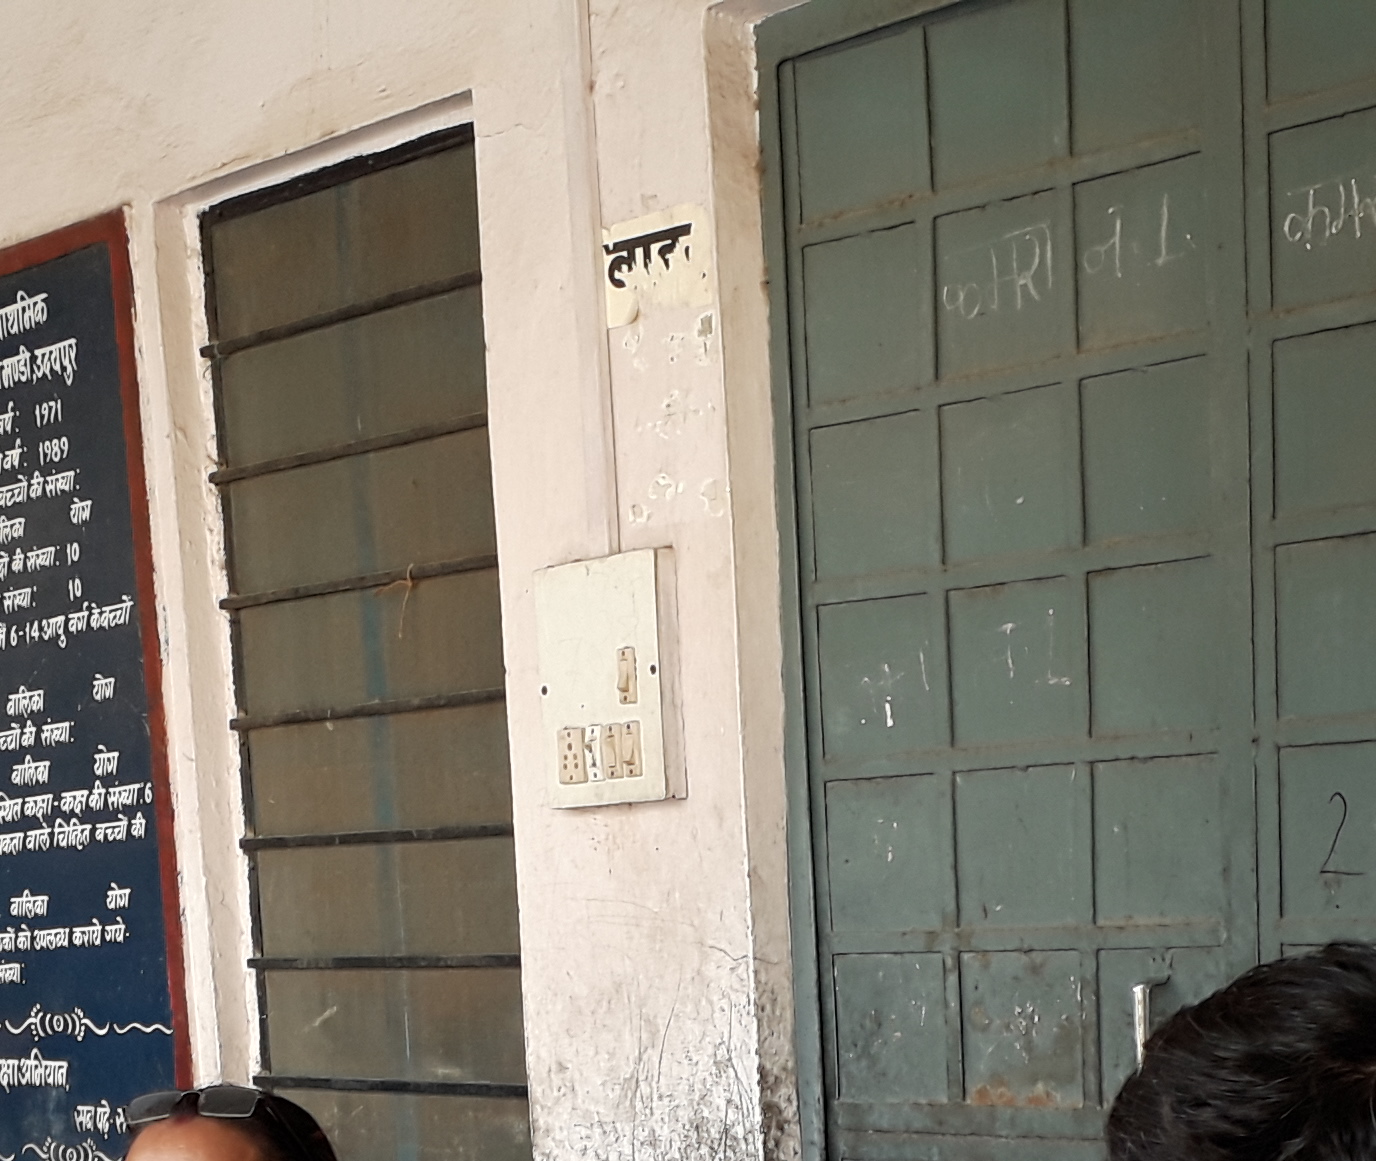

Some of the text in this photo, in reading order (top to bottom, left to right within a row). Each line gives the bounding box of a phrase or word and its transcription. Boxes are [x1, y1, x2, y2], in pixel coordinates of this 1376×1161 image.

[35, 399, 62, 428] 1971
[39, 436, 69, 466] 1989
[29, 470, 44, 500] की
[70, 497, 93, 525] योग
[11, 547, 24, 574] की
[66, 542, 80, 566] 10
[68, 577, 82, 601] 10
[10, 619, 39, 647] 6-14
[41, 615, 67, 649] आयु
[68, 601, 89, 635] वर्ग
[6, 685, 44, 718] बालिका
[92, 673, 115, 702] योग
[21, 720, 36, 748] की
[11, 754, 51, 787] बालिका
[94, 744, 120, 777] योग
[89, 779, 106, 811] की
[144, 781, 153, 804] 6
[25, 822, 52, 851] वाले
[131, 811, 146, 839] की
[10, 888, 49, 918] बालिका
[106, 882, 131, 910] योग
[16, 923, 31, 951] को
